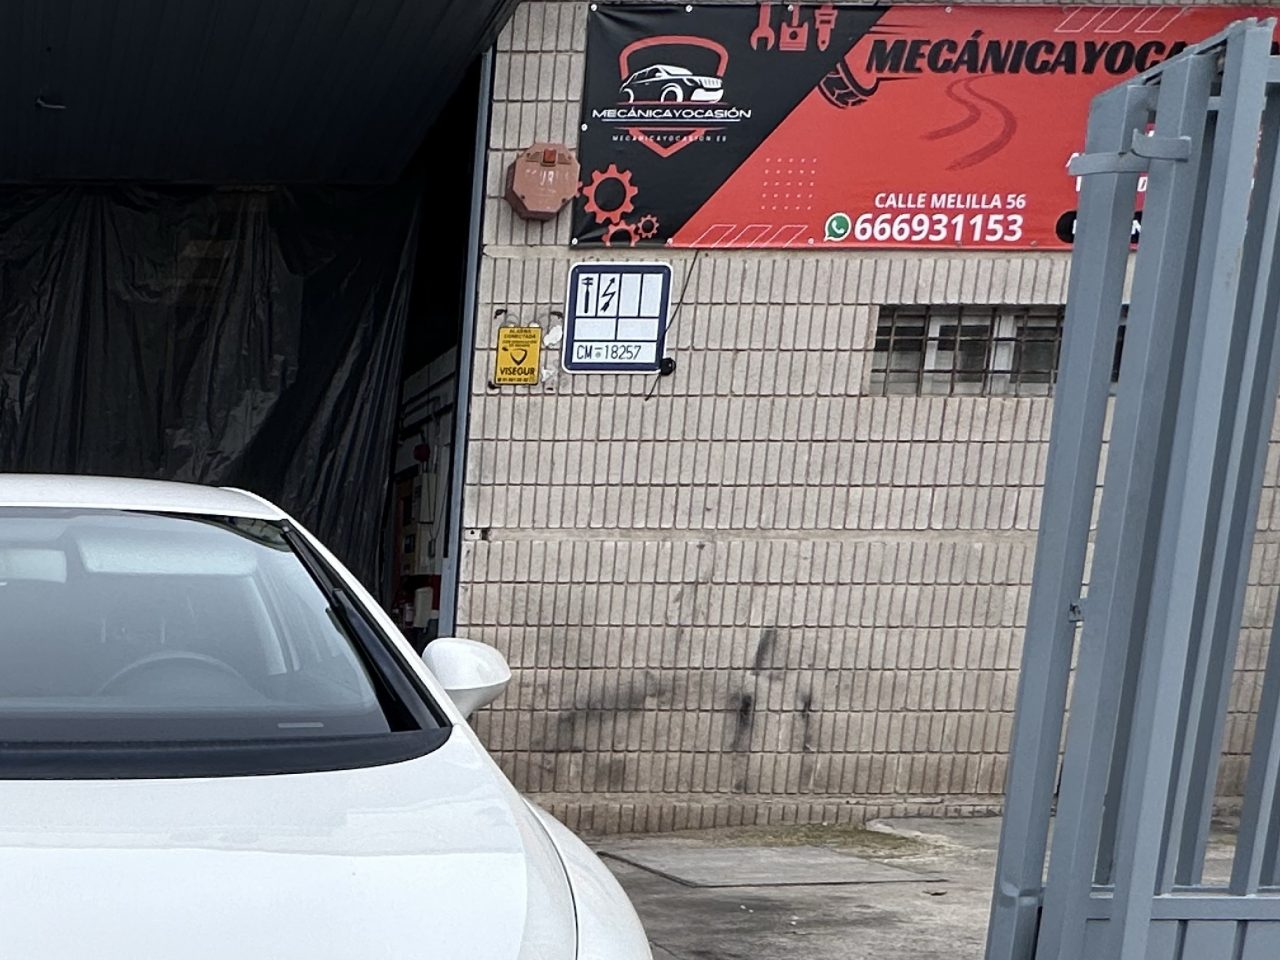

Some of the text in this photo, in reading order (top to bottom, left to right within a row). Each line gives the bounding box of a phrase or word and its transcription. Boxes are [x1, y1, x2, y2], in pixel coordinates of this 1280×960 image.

[592, 107, 752, 118] MECÁNICAYOCASIÓN
[874, 193, 1027, 209] CALLE MELILLA 56
[854, 212, 1024, 242] 666931153
